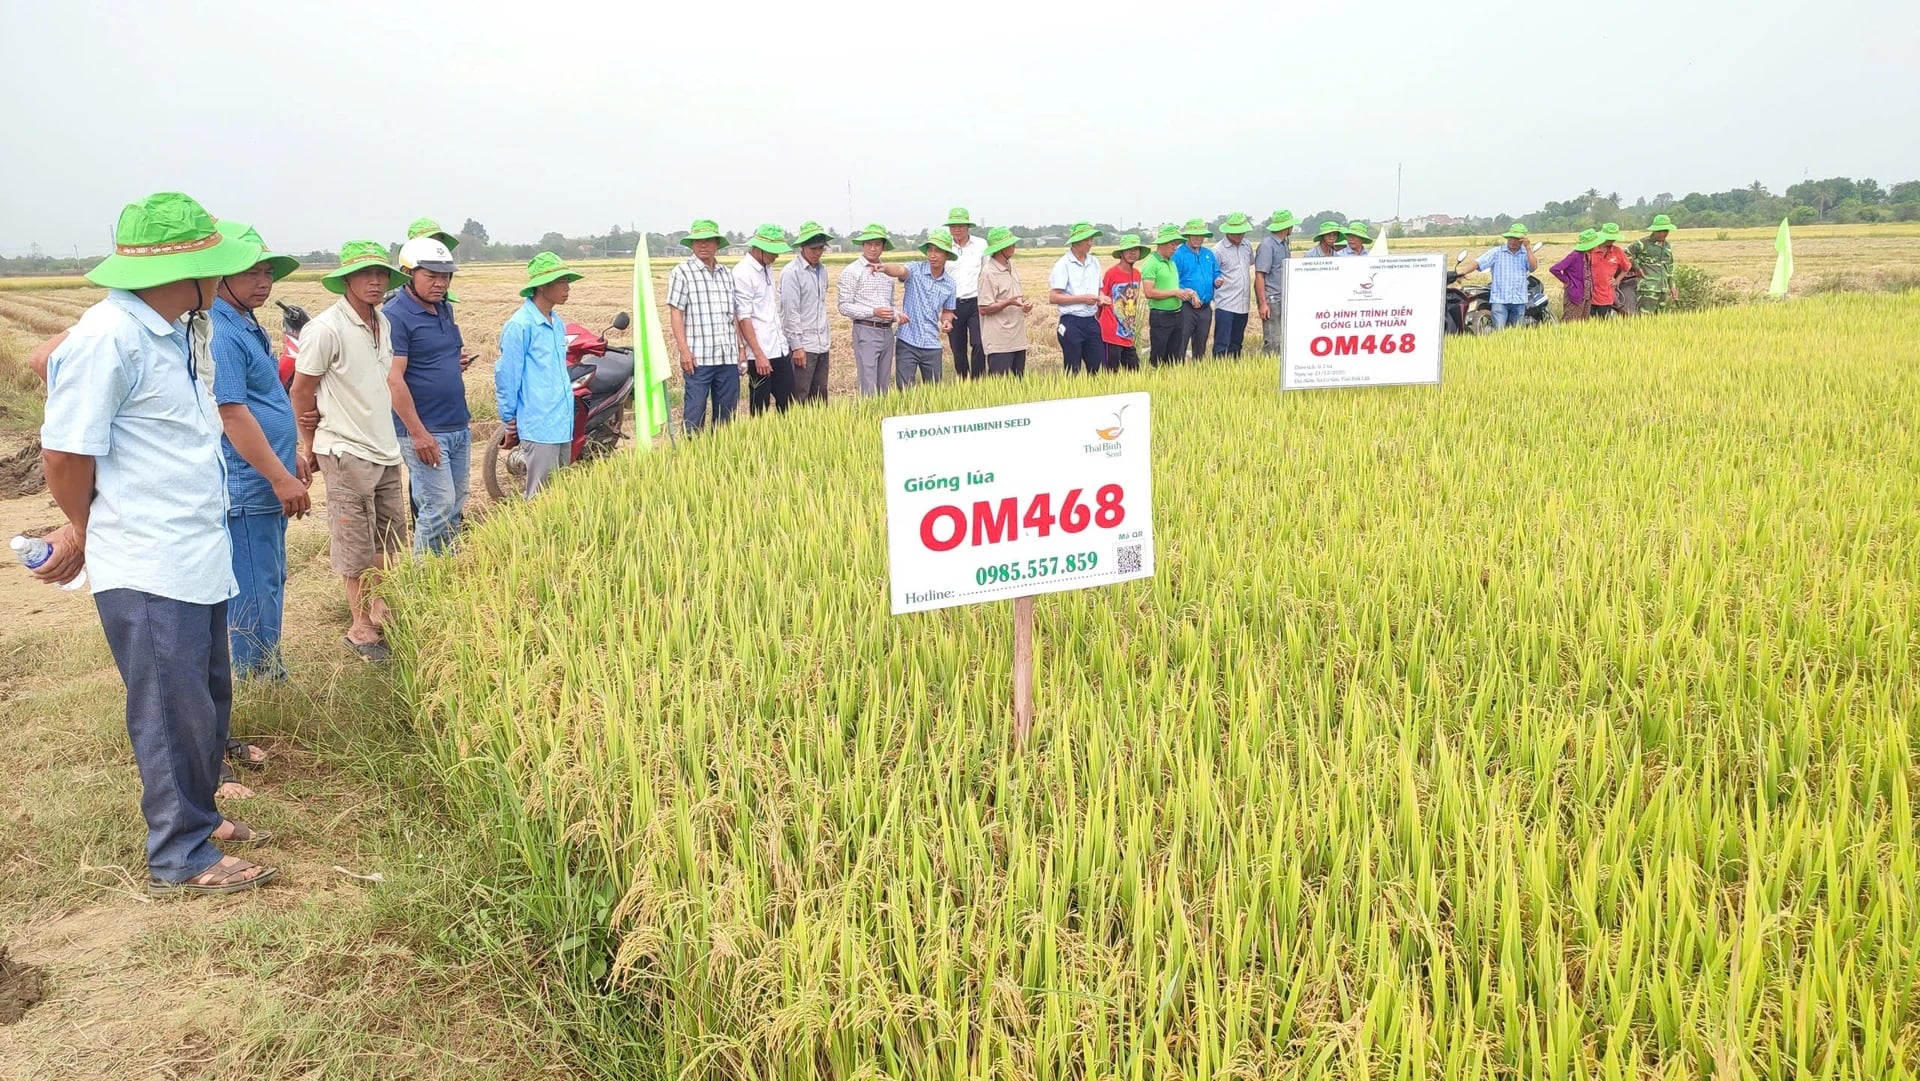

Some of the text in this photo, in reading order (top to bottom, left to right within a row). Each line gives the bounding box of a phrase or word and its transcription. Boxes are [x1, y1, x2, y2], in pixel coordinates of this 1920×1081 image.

[1320, 316, 1408, 330] GIỐNG LÚA THUẦN
[1333, 308, 1358, 319] HÌNH
[1360, 307, 1389, 318] TRÌNH
[1310, 332, 1416, 357] OM468
[897, 417, 1031, 440] TẬP ĐOÀN THAIBINH SEED
[904, 469, 994, 492] Giống lúa
[919, 483, 1126, 552] OM468
[1131, 530, 1144, 538] QR
[975, 550, 1099, 586] 0985.557.859
